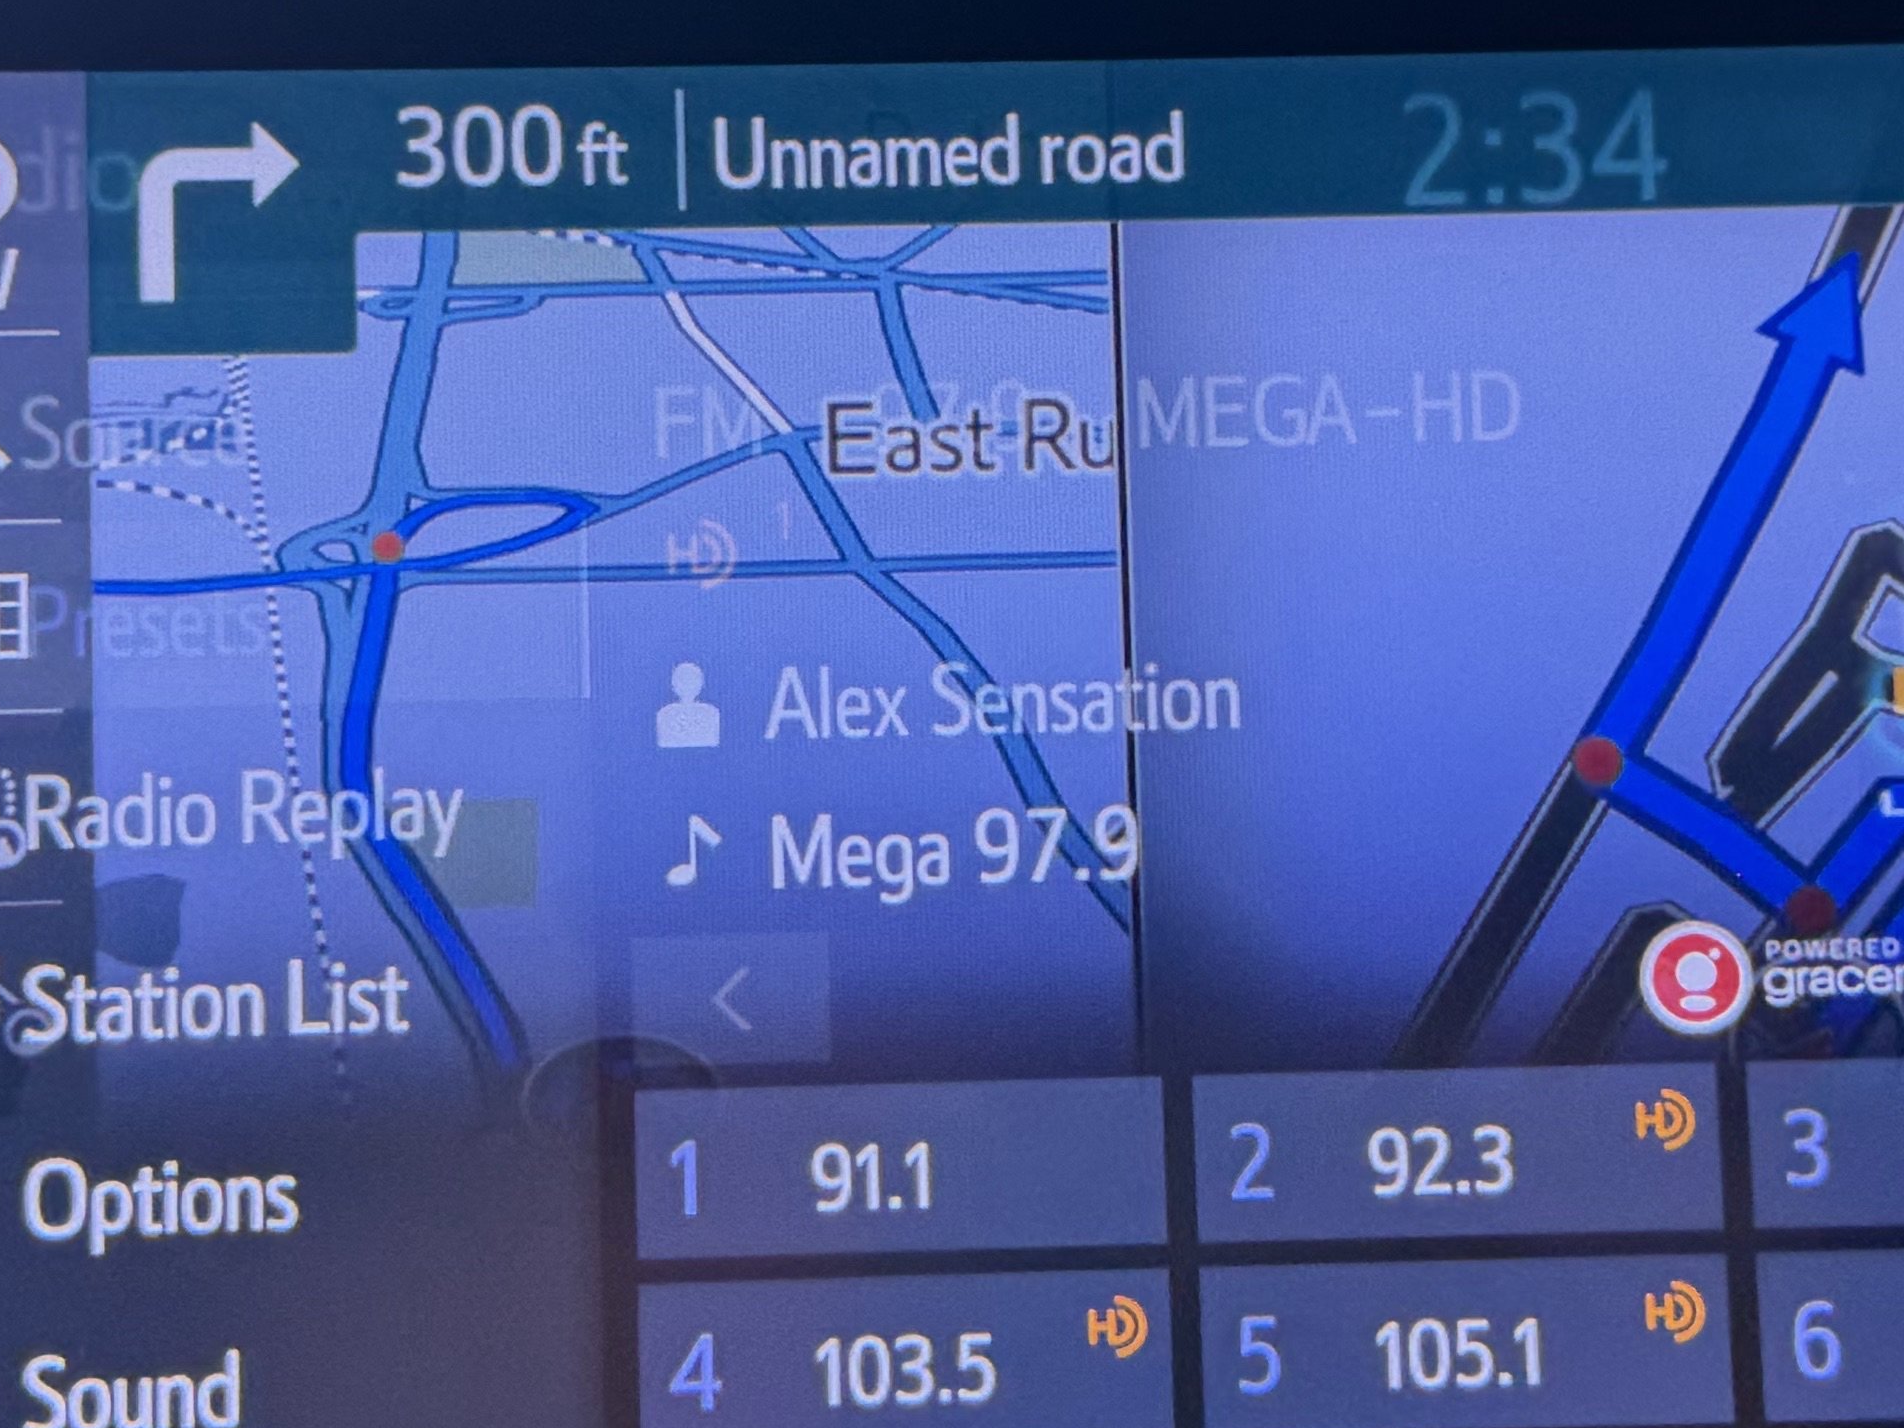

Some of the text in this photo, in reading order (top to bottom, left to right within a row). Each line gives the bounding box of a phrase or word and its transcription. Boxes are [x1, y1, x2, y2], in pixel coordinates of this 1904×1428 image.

[396, 104, 1185, 190] 300 ft Unnamed road
[1403, 88, 1668, 208] 2:34
[826, 399, 997, 476] East
[1024, 398, 1117, 472] Ru
[764, 660, 1242, 742] Alex Sensation
[25, 766, 464, 859] Radio Replay
[770, 804, 1141, 904] Mega 97.9
[1765, 935, 1900, 960] POWERED
[20, 958, 412, 1047] Station List
[669, 1139, 934, 1217] 1 91.1
[1230, 1122, 1275, 1202] 2
[1367, 1125, 1514, 1198] 92.3
[1783, 1107, 1830, 1188] 3
[22, 1156, 300, 1257] Options
[669, 1332, 724, 1413] 4
[814, 1331, 998, 1410] 103.5
[1237, 1314, 1282, 1396] 5
[1374, 1317, 1543, 1391] 105.1
[1793, 1301, 1843, 1381] 6
